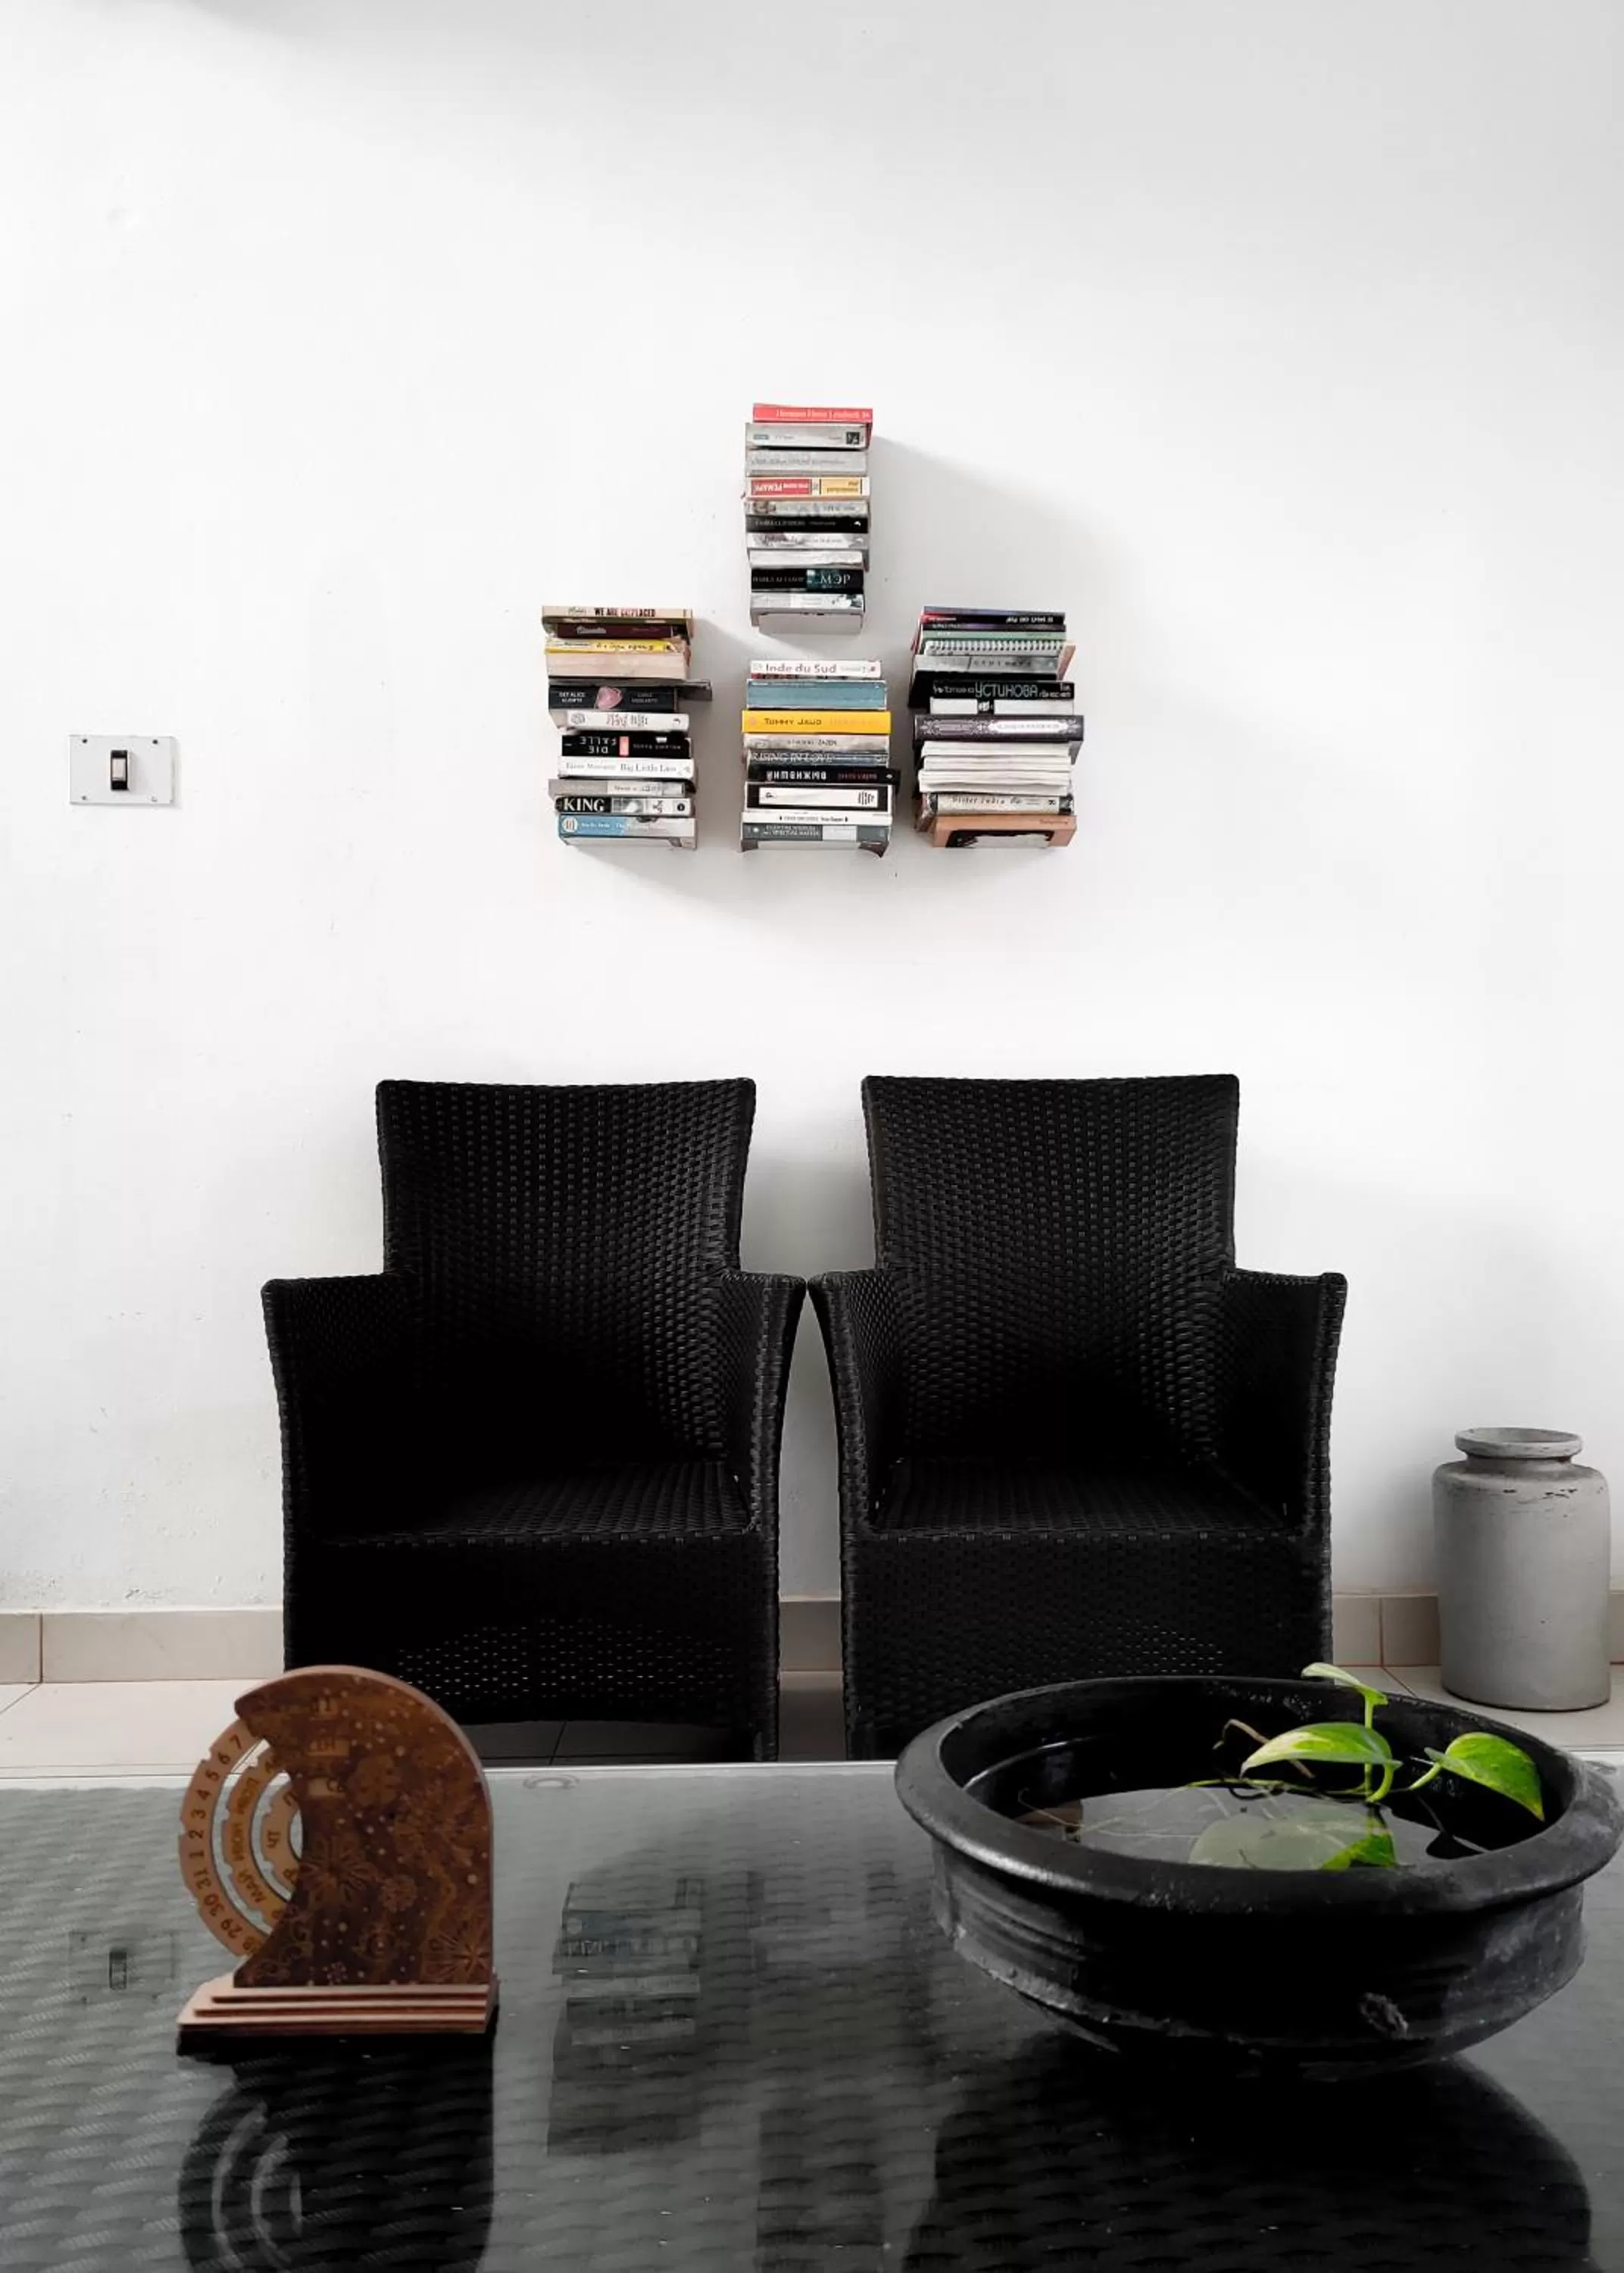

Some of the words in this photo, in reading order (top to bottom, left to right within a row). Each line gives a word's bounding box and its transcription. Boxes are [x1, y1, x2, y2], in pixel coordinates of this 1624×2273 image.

[594, 608, 604, 617] WE
[766, 663, 793, 672] Inde
[795, 663, 811, 673] du
[814, 663, 837, 674] Sud
[564, 798, 605, 813] KING
[230, 1735, 242, 1749] 7
[217, 1752, 231, 1765] 6
[207, 1768, 220, 1781] 5
[199, 1790, 212, 1801] 4
[191, 1809, 206, 1819] 3
[189, 1829, 204, 1839] 2
[267, 1829, 282, 1848] ЧТ
[193, 1868, 212, 1889] 31
[204, 1893, 225, 1916] 30
[220, 1918, 243, 1939] 29
